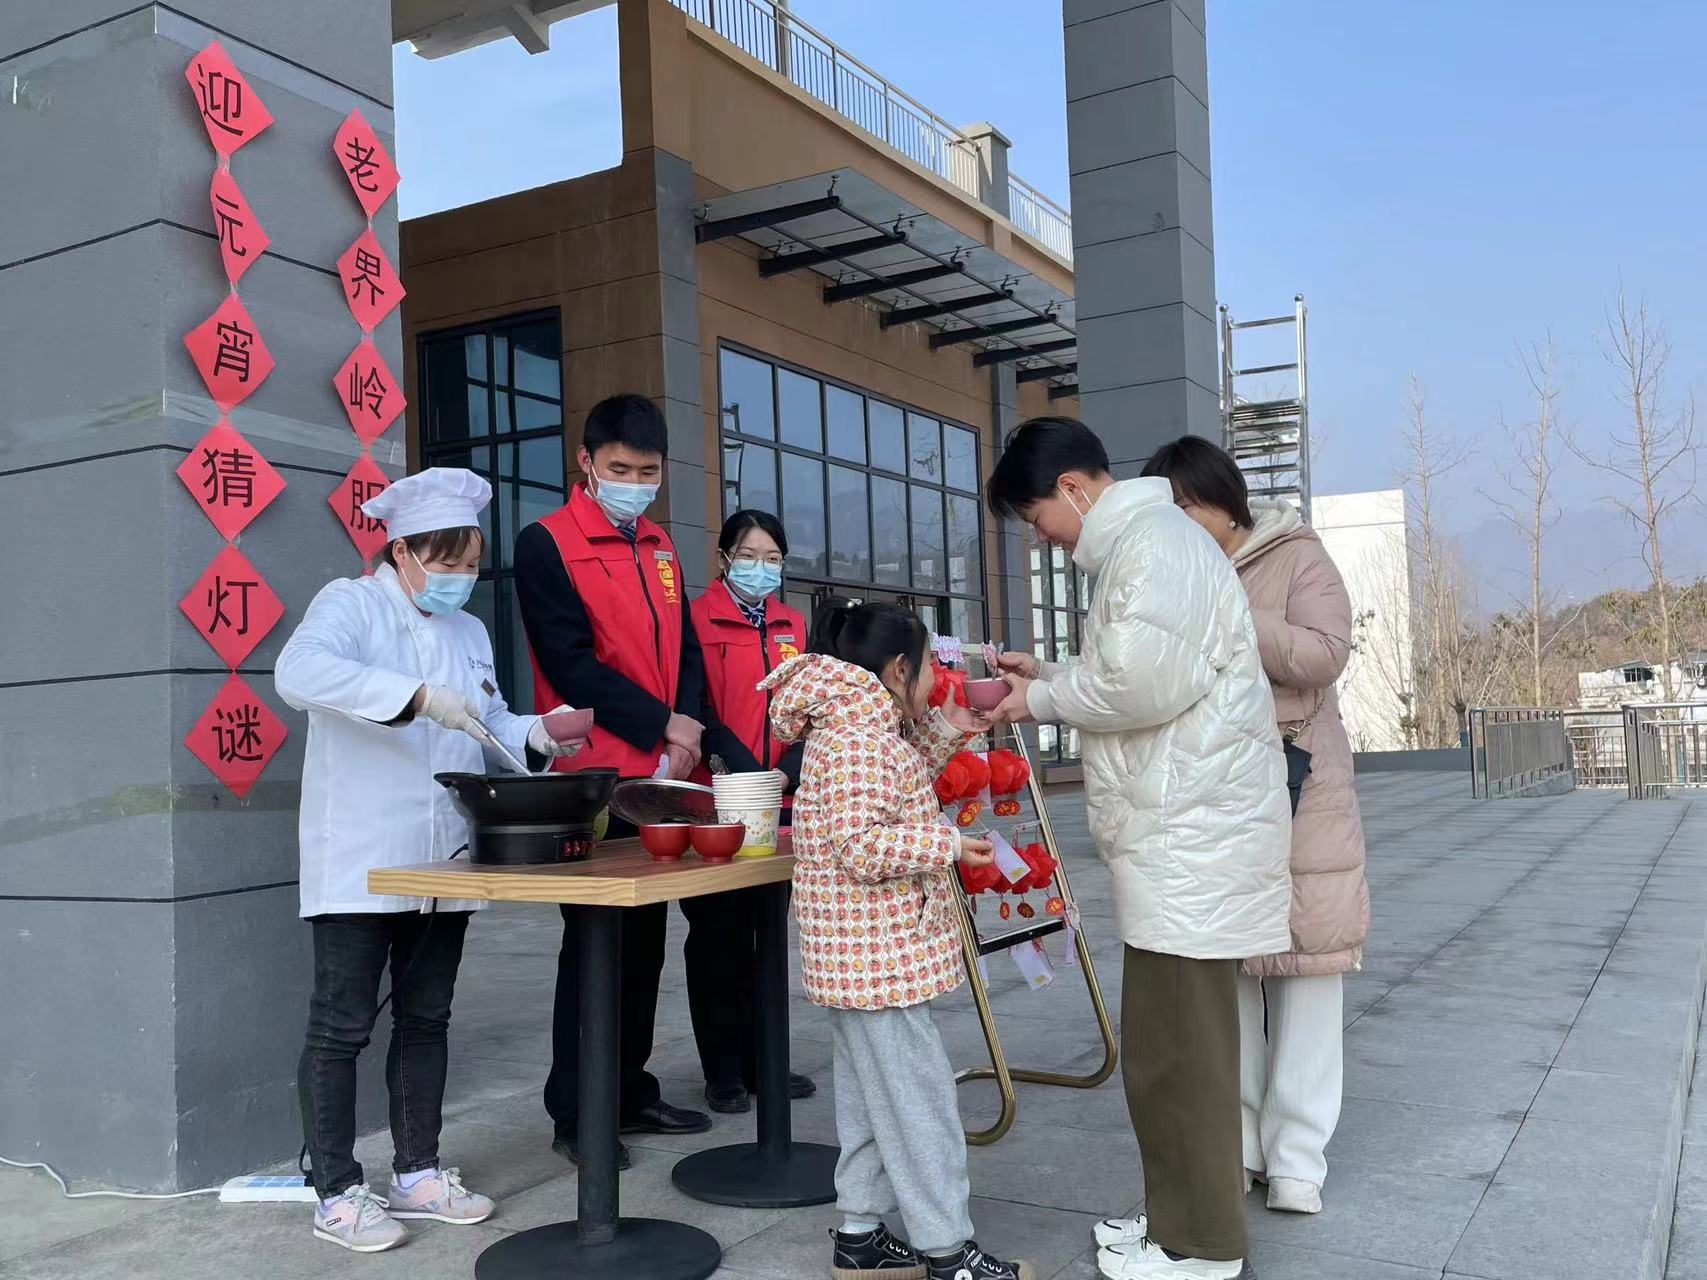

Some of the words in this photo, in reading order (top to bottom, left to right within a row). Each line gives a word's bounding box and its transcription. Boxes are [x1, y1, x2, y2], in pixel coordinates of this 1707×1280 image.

[197, 63, 264, 765] 迎元宵猜灯谜
